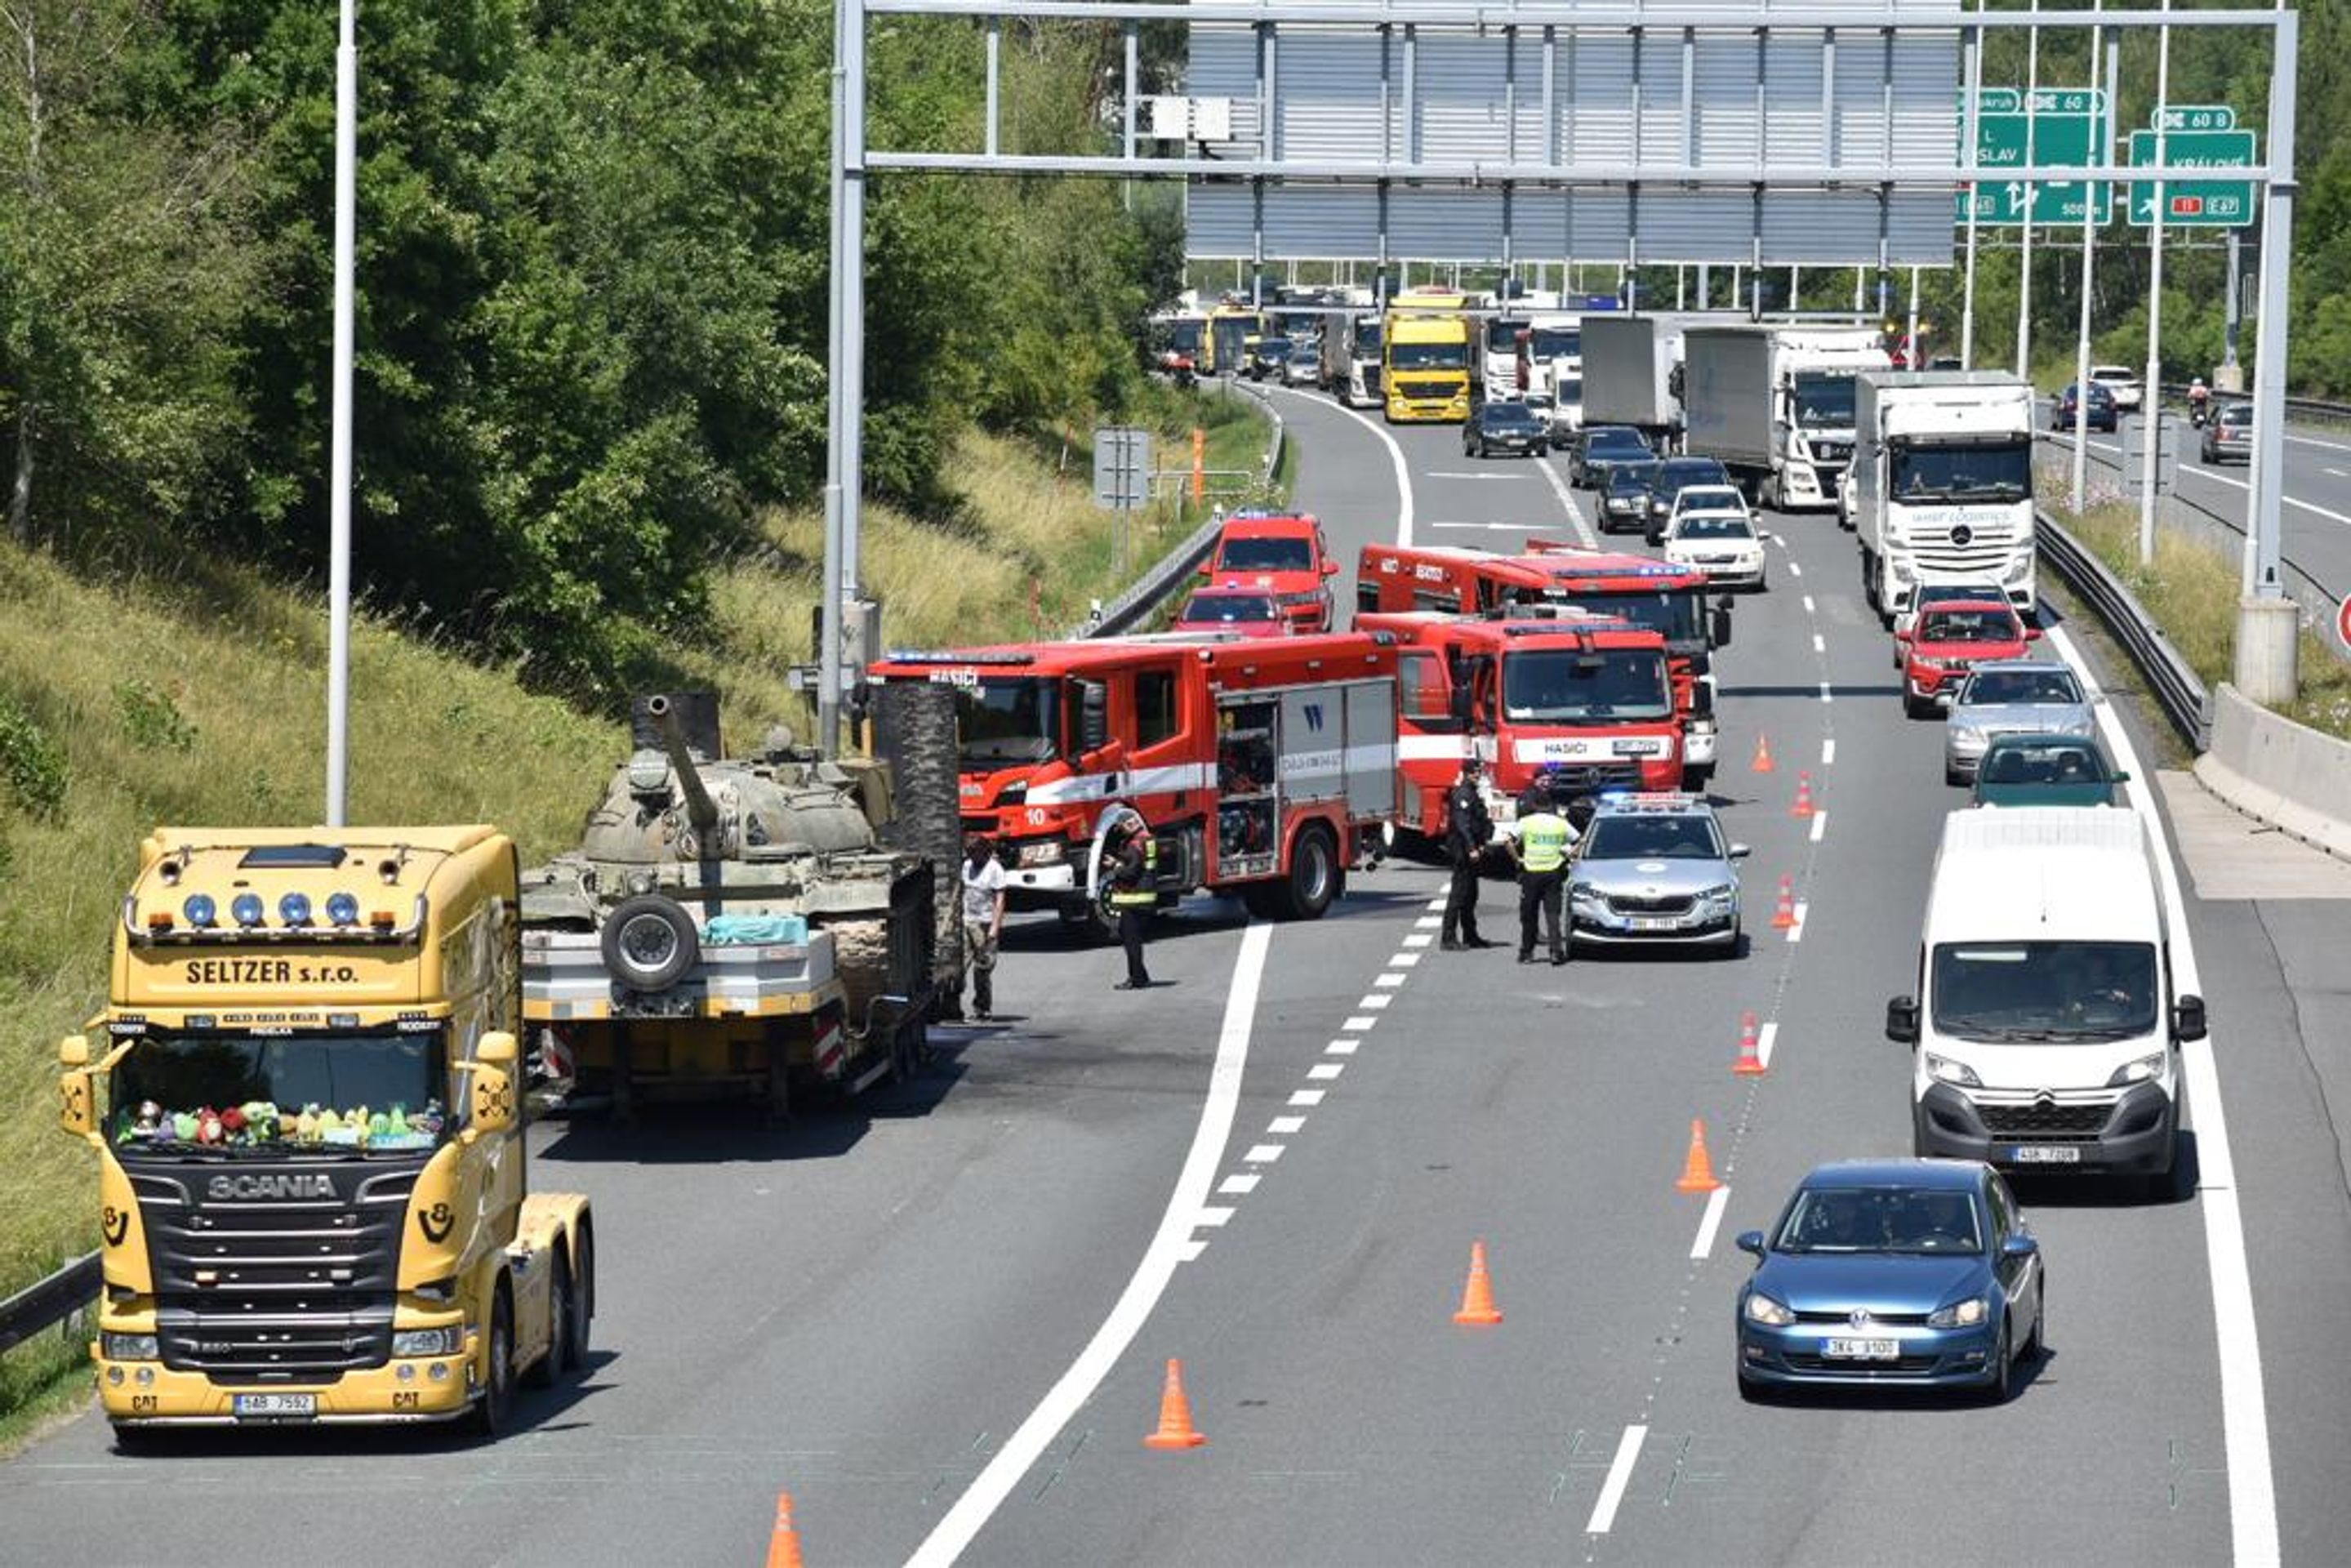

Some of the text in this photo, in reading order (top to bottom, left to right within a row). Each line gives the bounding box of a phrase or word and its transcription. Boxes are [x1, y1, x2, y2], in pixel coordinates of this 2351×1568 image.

[2192, 113, 2227, 127] 60 B
[1978, 148, 2017, 163] SLAV
[1544, 742, 1587, 755] HASIČI
[1025, 808, 1045, 827] 10
[187, 960, 359, 984] SELTZER s.r.o.
[208, 1174, 337, 1199] SCANIA
